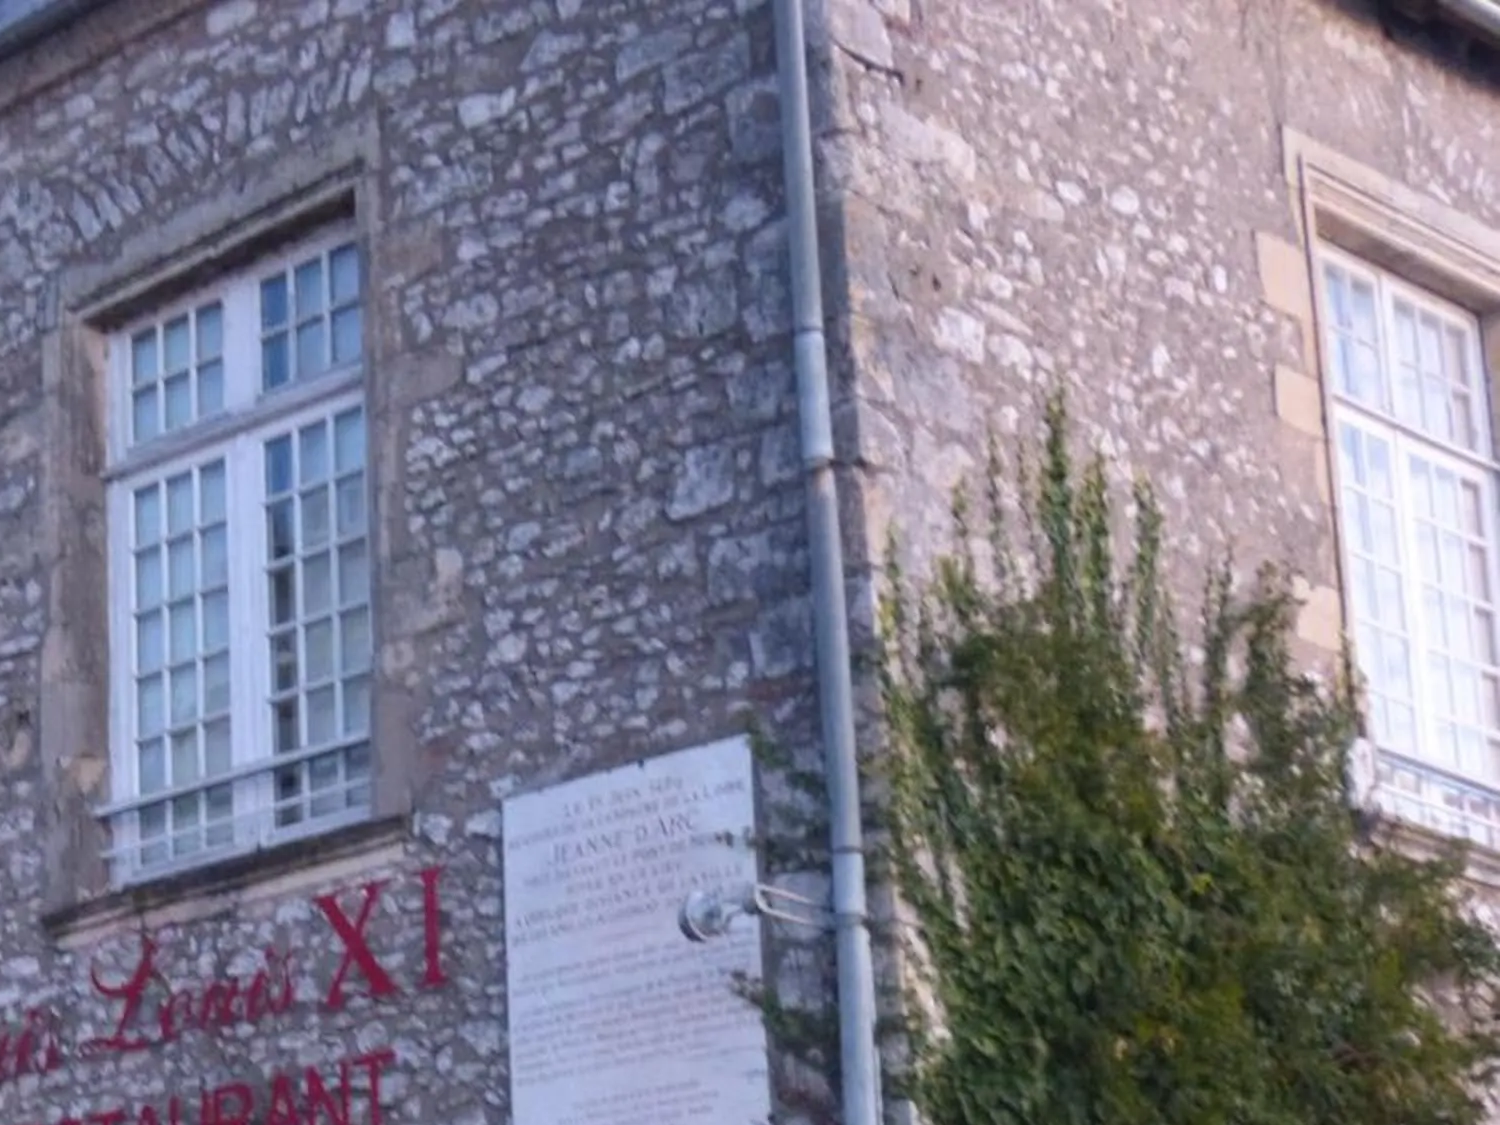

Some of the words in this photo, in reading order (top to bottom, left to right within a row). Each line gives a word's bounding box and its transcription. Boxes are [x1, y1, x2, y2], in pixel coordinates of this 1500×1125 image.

[547, 829, 622, 866] JEANNE
[75, 918, 296, 1060] Louis
[312, 866, 448, 1012] XI
